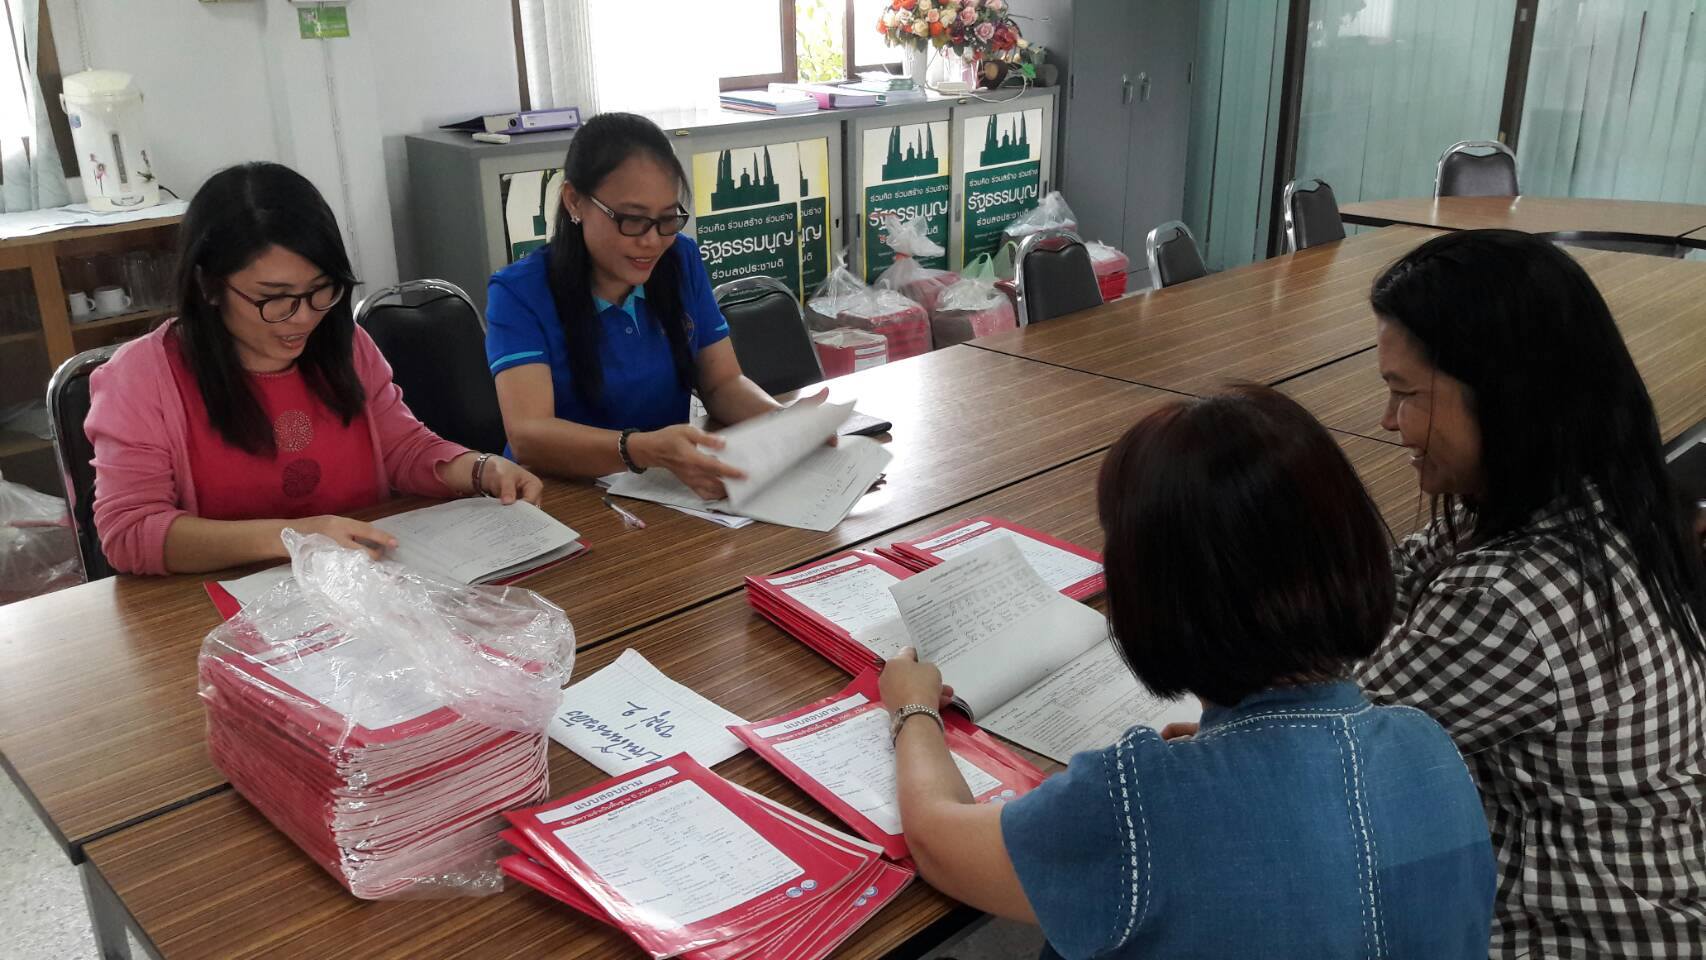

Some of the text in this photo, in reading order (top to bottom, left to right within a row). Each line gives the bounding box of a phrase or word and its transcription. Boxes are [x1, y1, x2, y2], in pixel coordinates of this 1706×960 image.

[968, 184, 1038, 214] รัฐธรรมนูญ
[697, 212, 794, 234] ร่วมคิด ร่วมสร้าง ร่วมร่าง
[699, 230, 794, 265] รัฐธรรมนูญ
[711, 258, 784, 280] ร่วมลงประชามติ
[573, 779, 644, 811] แบบสอบถาม
